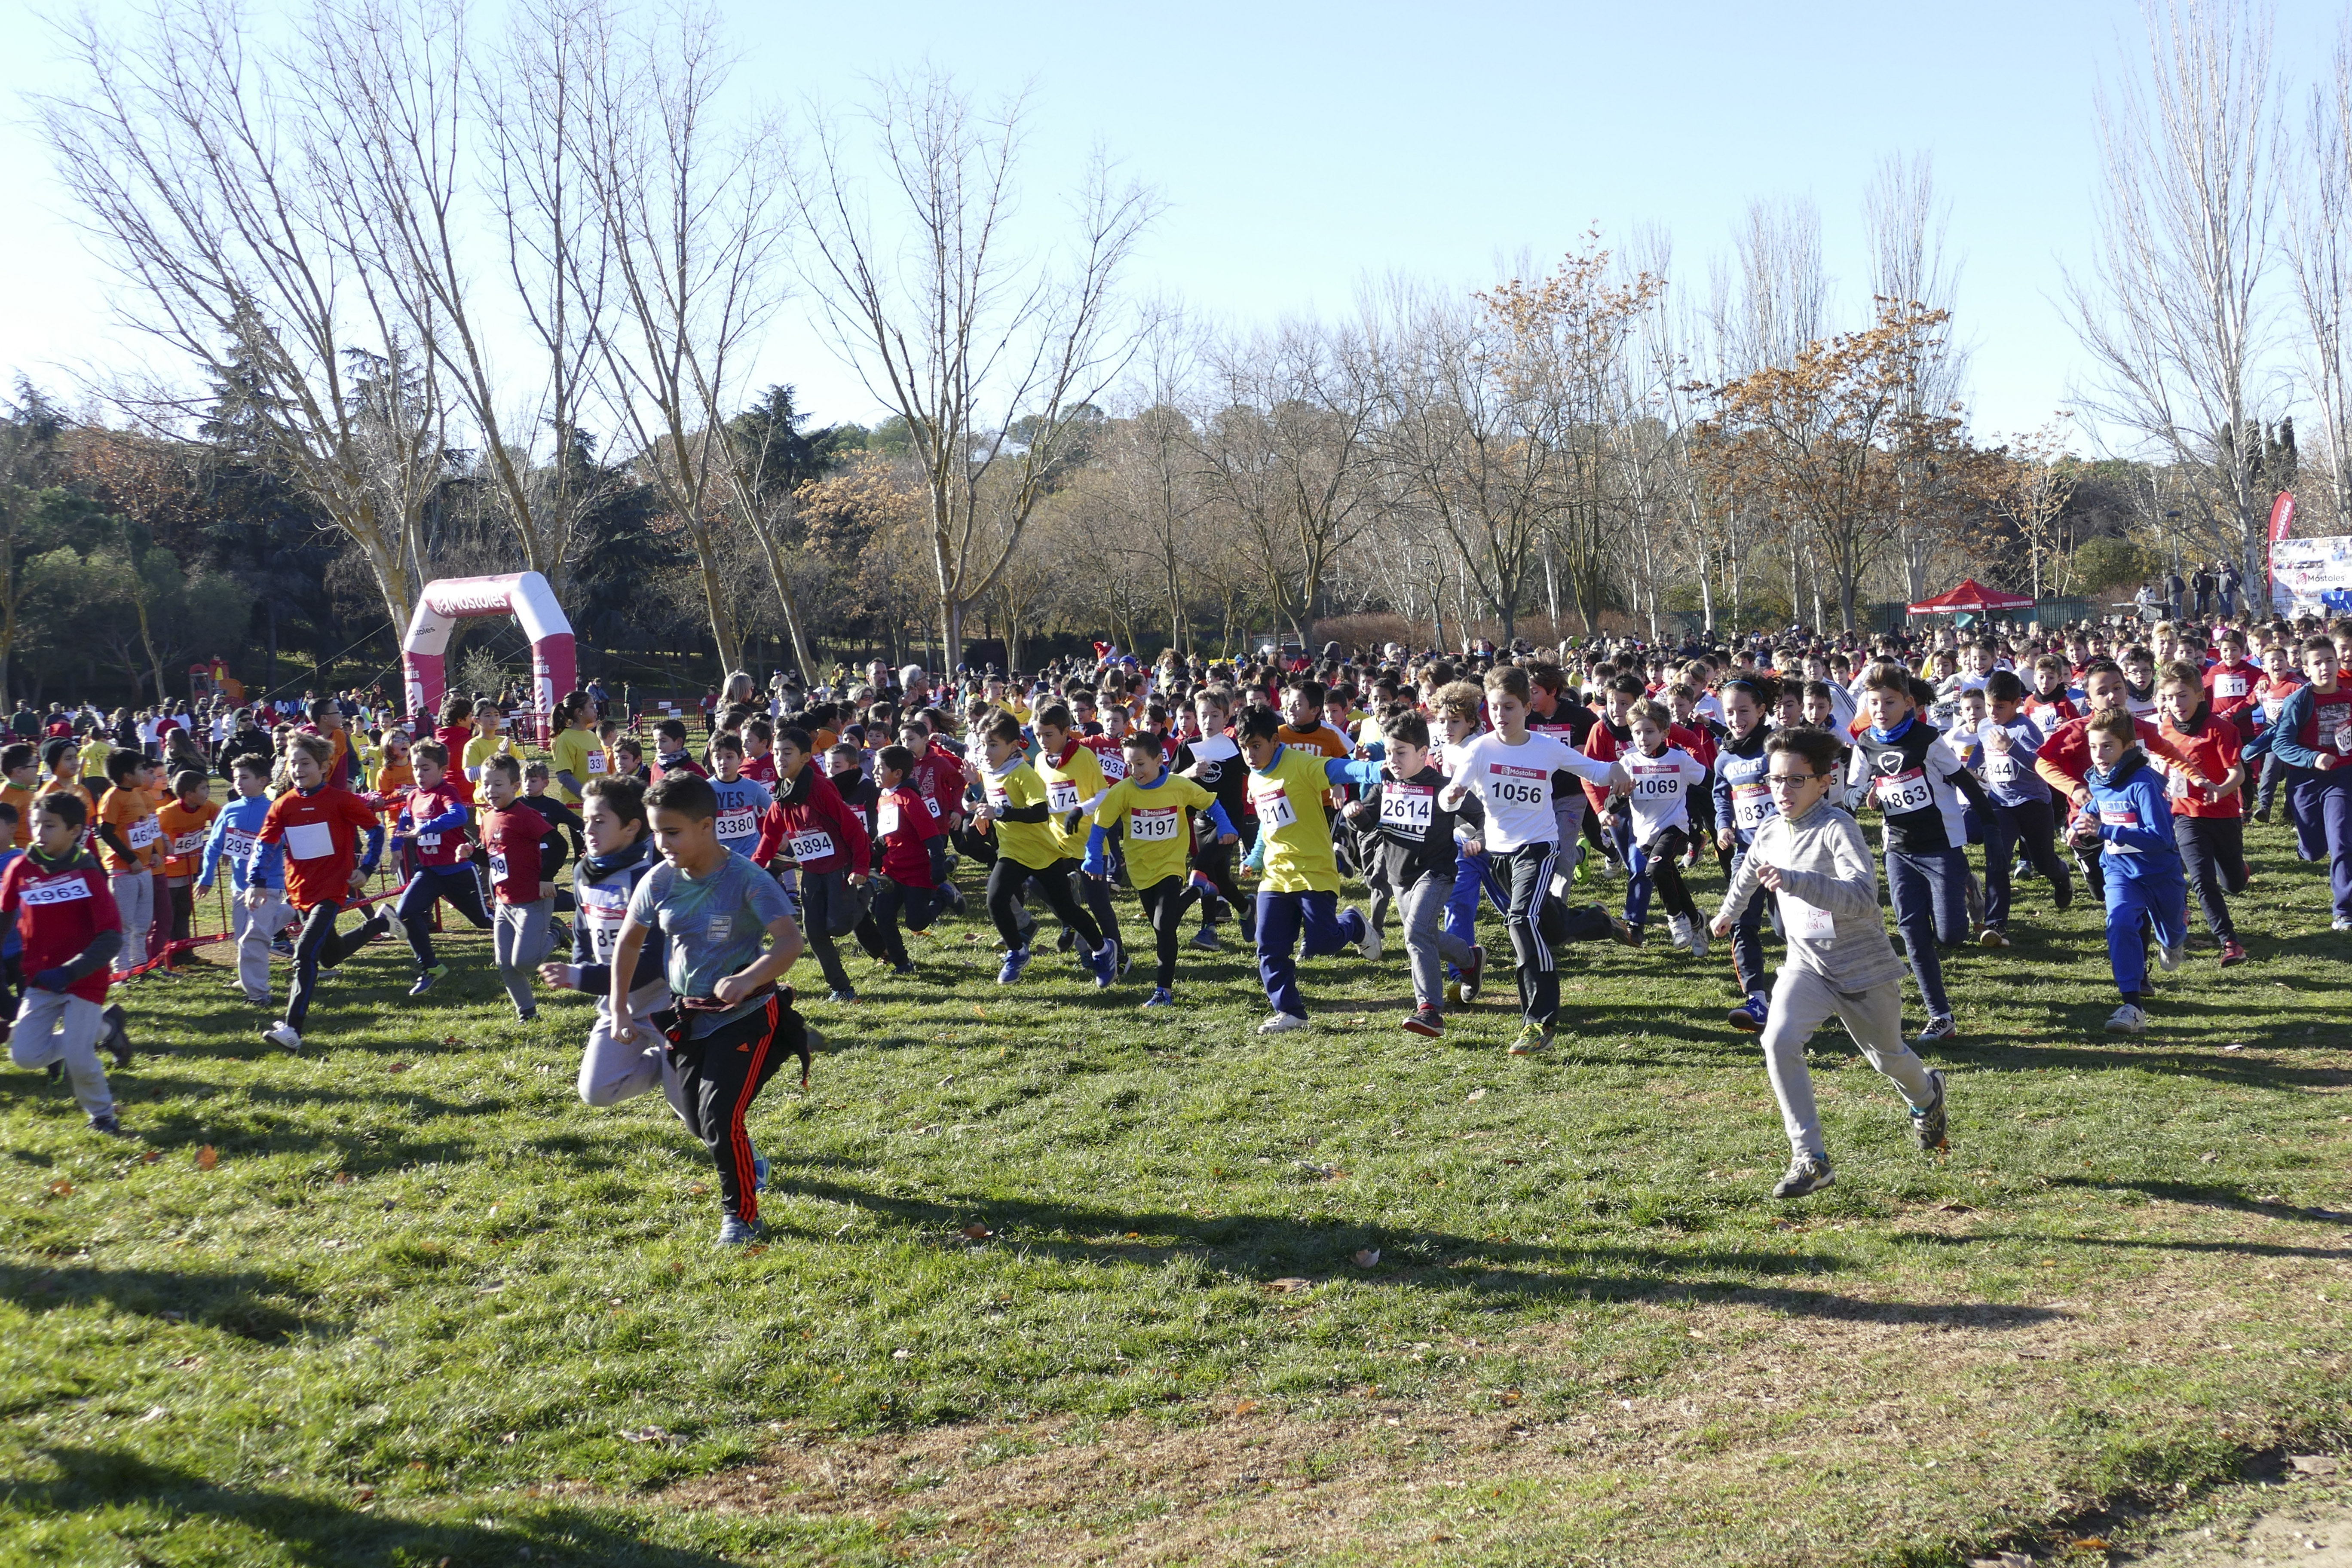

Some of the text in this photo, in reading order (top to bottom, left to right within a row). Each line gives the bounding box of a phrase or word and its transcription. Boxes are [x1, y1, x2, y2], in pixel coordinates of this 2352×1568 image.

[1510, 768, 1537, 778] Móstoles
[1492, 782, 1542, 804] 1056
[1636, 779, 1678, 794] 1069
[717, 791, 744, 808] YES
[1884, 785, 1927, 809] 1863
[1383, 799, 1429, 819] 2614
[717, 816, 753, 834] 3380
[1133, 817, 1175, 836] 3197
[794, 836, 831, 856] 3894
[27, 885, 86, 902] 4963
